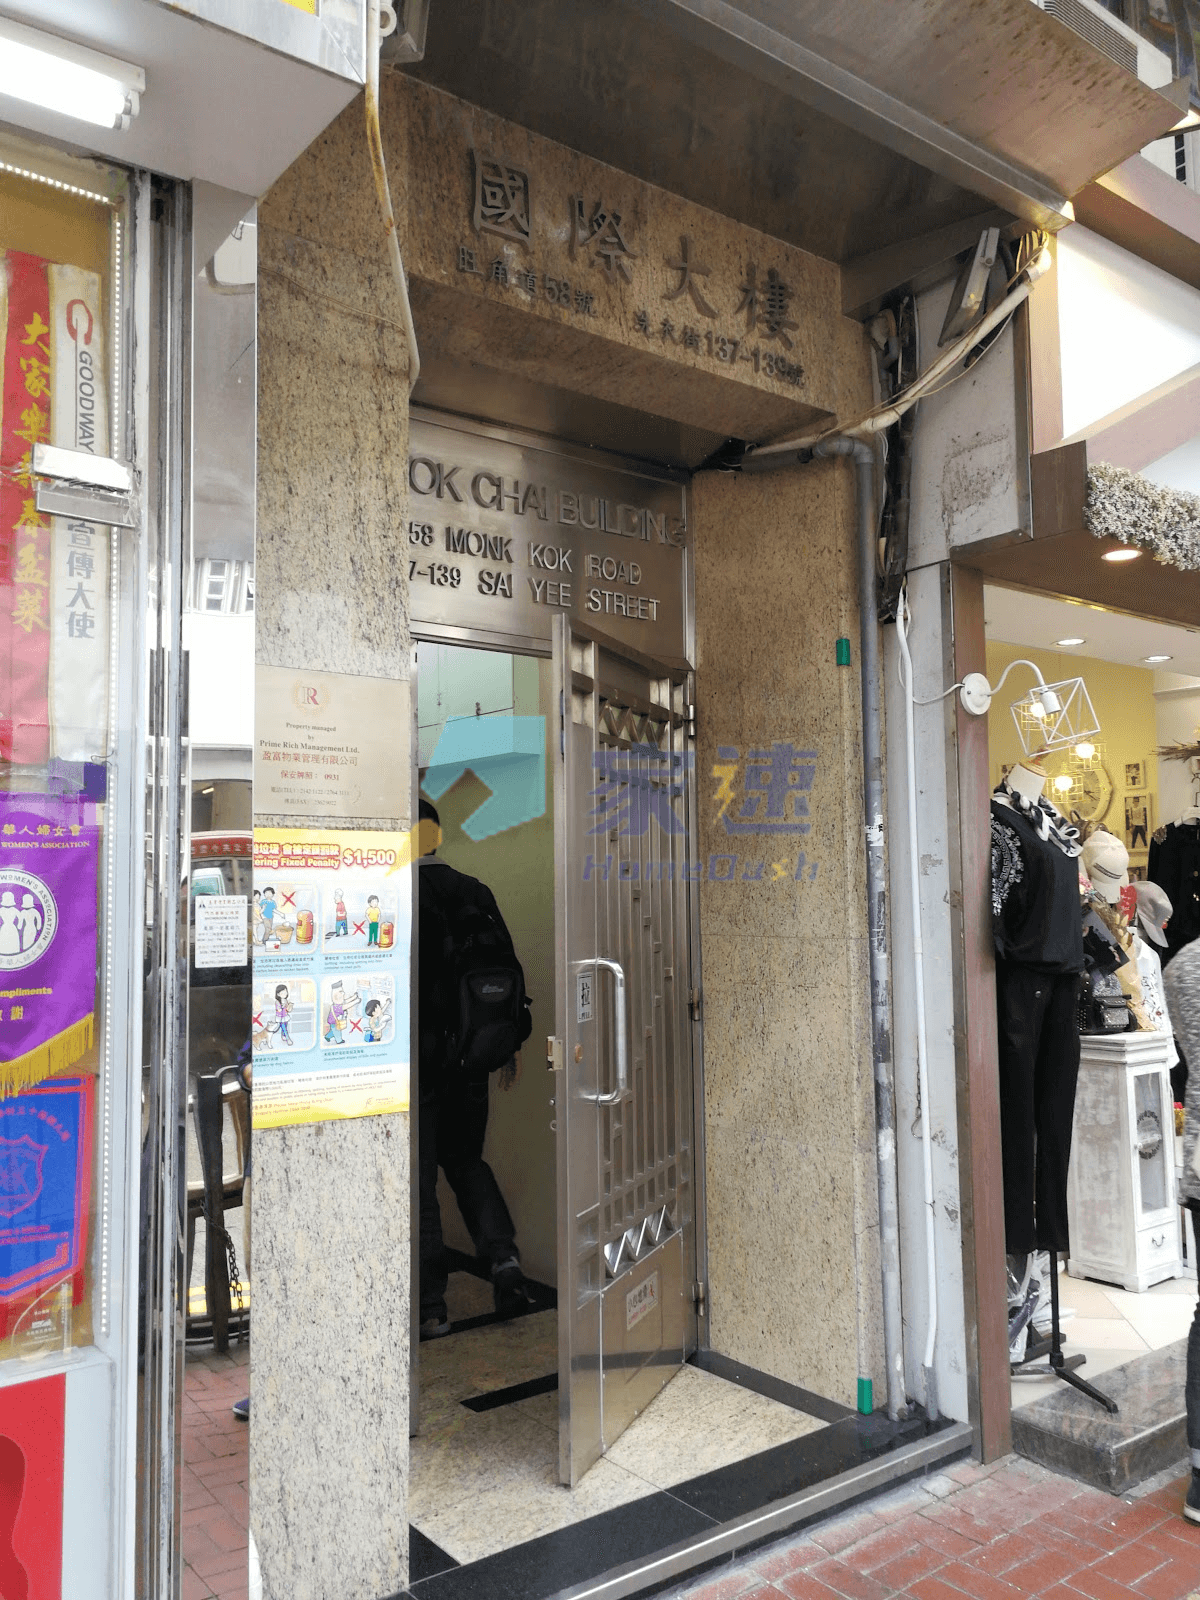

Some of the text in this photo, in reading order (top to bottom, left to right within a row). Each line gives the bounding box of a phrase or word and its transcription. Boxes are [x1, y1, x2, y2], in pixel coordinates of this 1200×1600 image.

[471, 147, 800, 350] 國際大樓
[457, 245, 598, 319] 旺角道58號
[632, 309, 805, 389] 洗衣街137-139號
[78, 350, 95, 454] GOODWAY
[471, 472, 548, 520] CHAI
[556, 490, 687, 548] BUILDING
[66, 522, 95, 639] 宣傳大使
[445, 526, 513, 563] MONK
[528, 542, 572, 573] KOK
[586, 553, 642, 585] ROAD
[478, 568, 513, 598] SAI
[527, 577, 571, 607] YEE
[586, 588, 660, 621] STREET
[259, 740, 360, 754] Prime Rich Management Ltd.
[286, 722, 336, 733] Property managed
[262, 751, 358, 766] 盈富物業管理有限公司
[324, 773, 340, 781] 0931
[1, 840, 90, 849] WOMEN'S ASSOCIATION
[280, 857, 306, 867] Fixed
[307, 857, 340, 870] Penalty
[343, 848, 397, 868] $1,500
